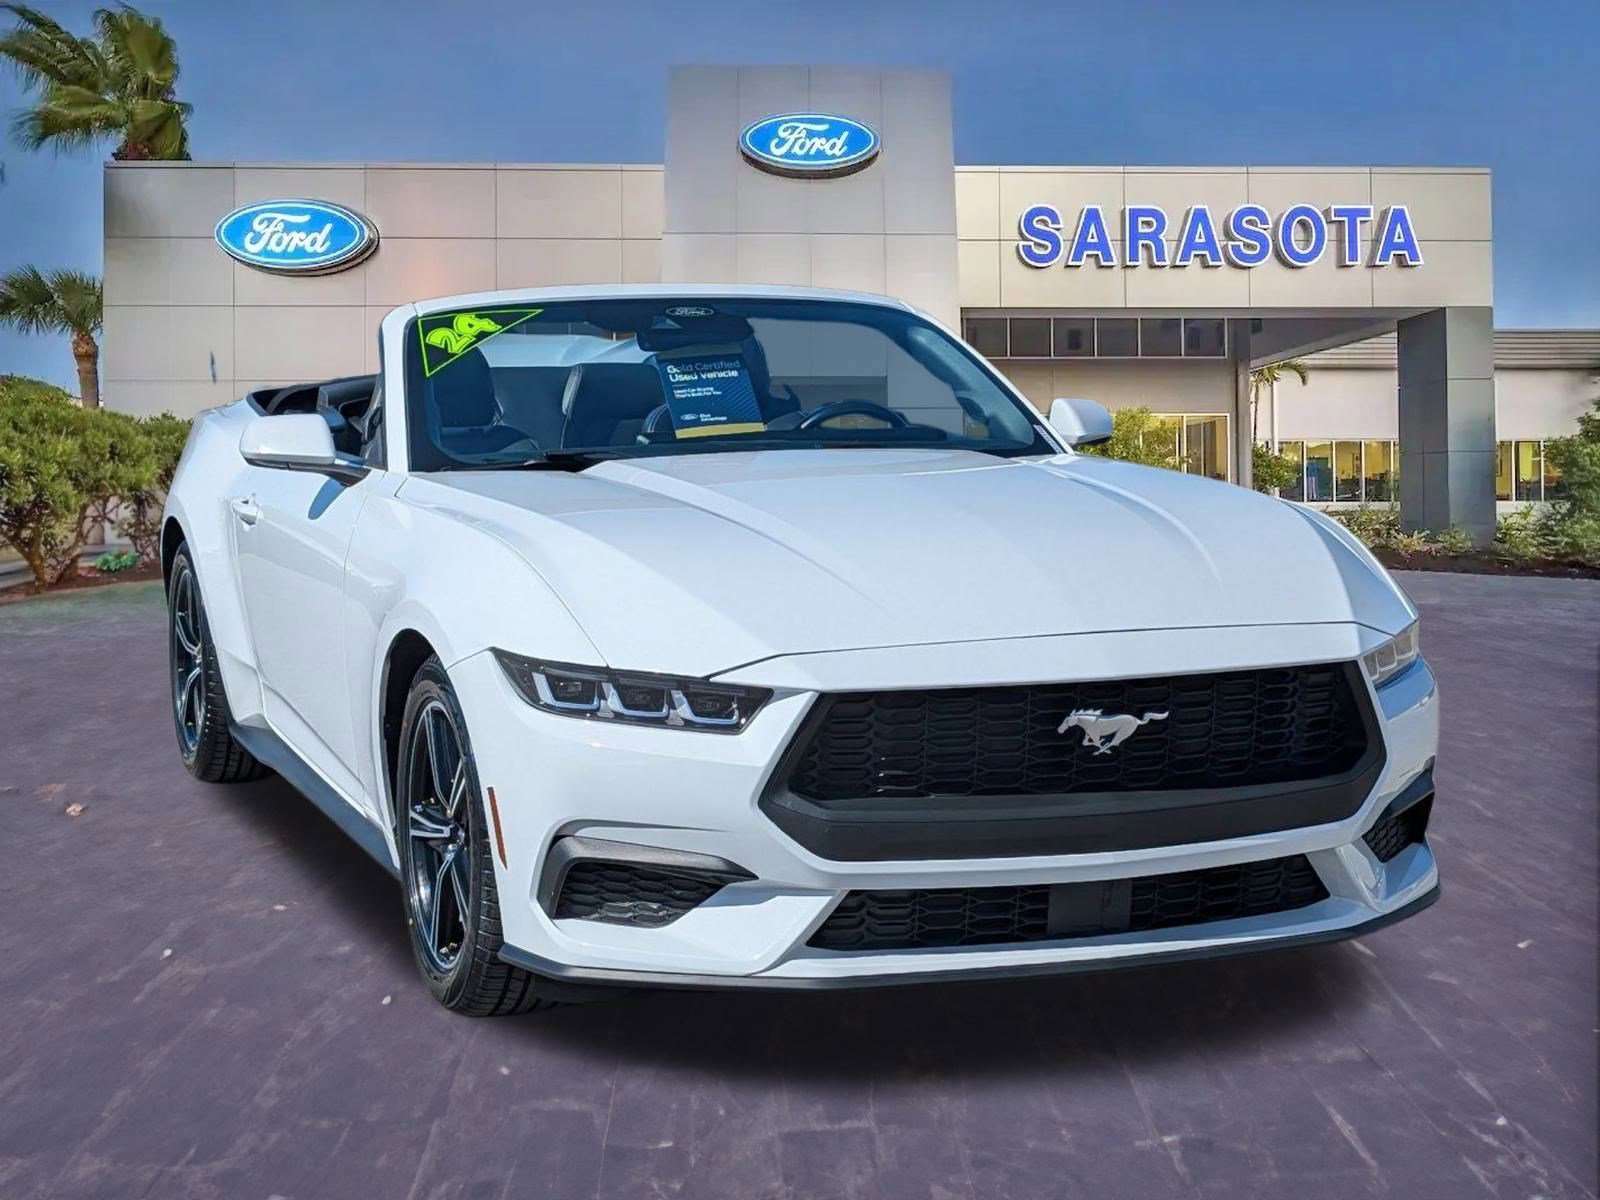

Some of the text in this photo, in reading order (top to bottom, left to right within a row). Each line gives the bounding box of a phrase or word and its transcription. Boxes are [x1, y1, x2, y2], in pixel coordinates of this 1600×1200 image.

[770, 122, 849, 156] Ford
[244, 212, 333, 253] Ford
[1018, 203, 1424, 269] SARASOTA
[669, 371, 698, 382] Used
[694, 360, 740, 371] Certified
